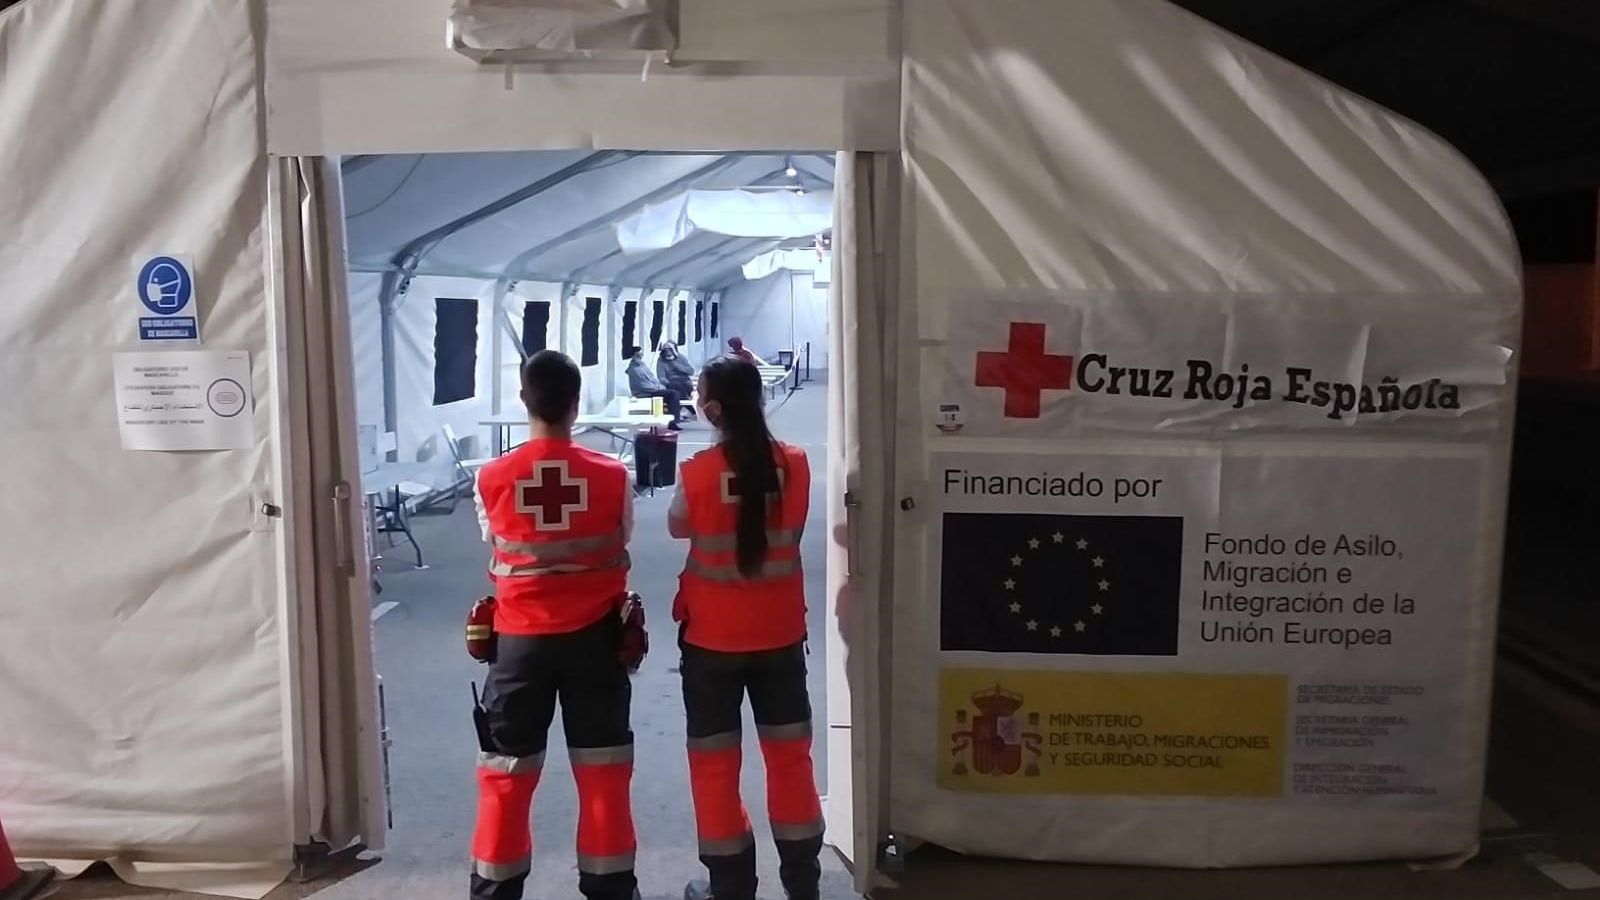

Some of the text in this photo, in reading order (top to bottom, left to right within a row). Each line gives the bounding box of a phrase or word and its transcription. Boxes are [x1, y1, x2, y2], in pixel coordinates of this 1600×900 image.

[1077, 353, 1461, 420] Cruz Roja Española
[944, 469, 1163, 503] Financiado por
[1205, 532, 1404, 560] Fondo de Asilo,
[1203, 560, 1353, 588] Migración e
[1201, 590, 1416, 617] Integración de la
[1200, 621, 1393, 650] Unión Europea
[1049, 712, 1144, 729] MINISTERIO
[1049, 732, 1071, 747] DE
[1153, 734, 1271, 750] MIGRACIONES
[1049, 752, 1225, 769] Y SEGURIDAD SOCIAL
